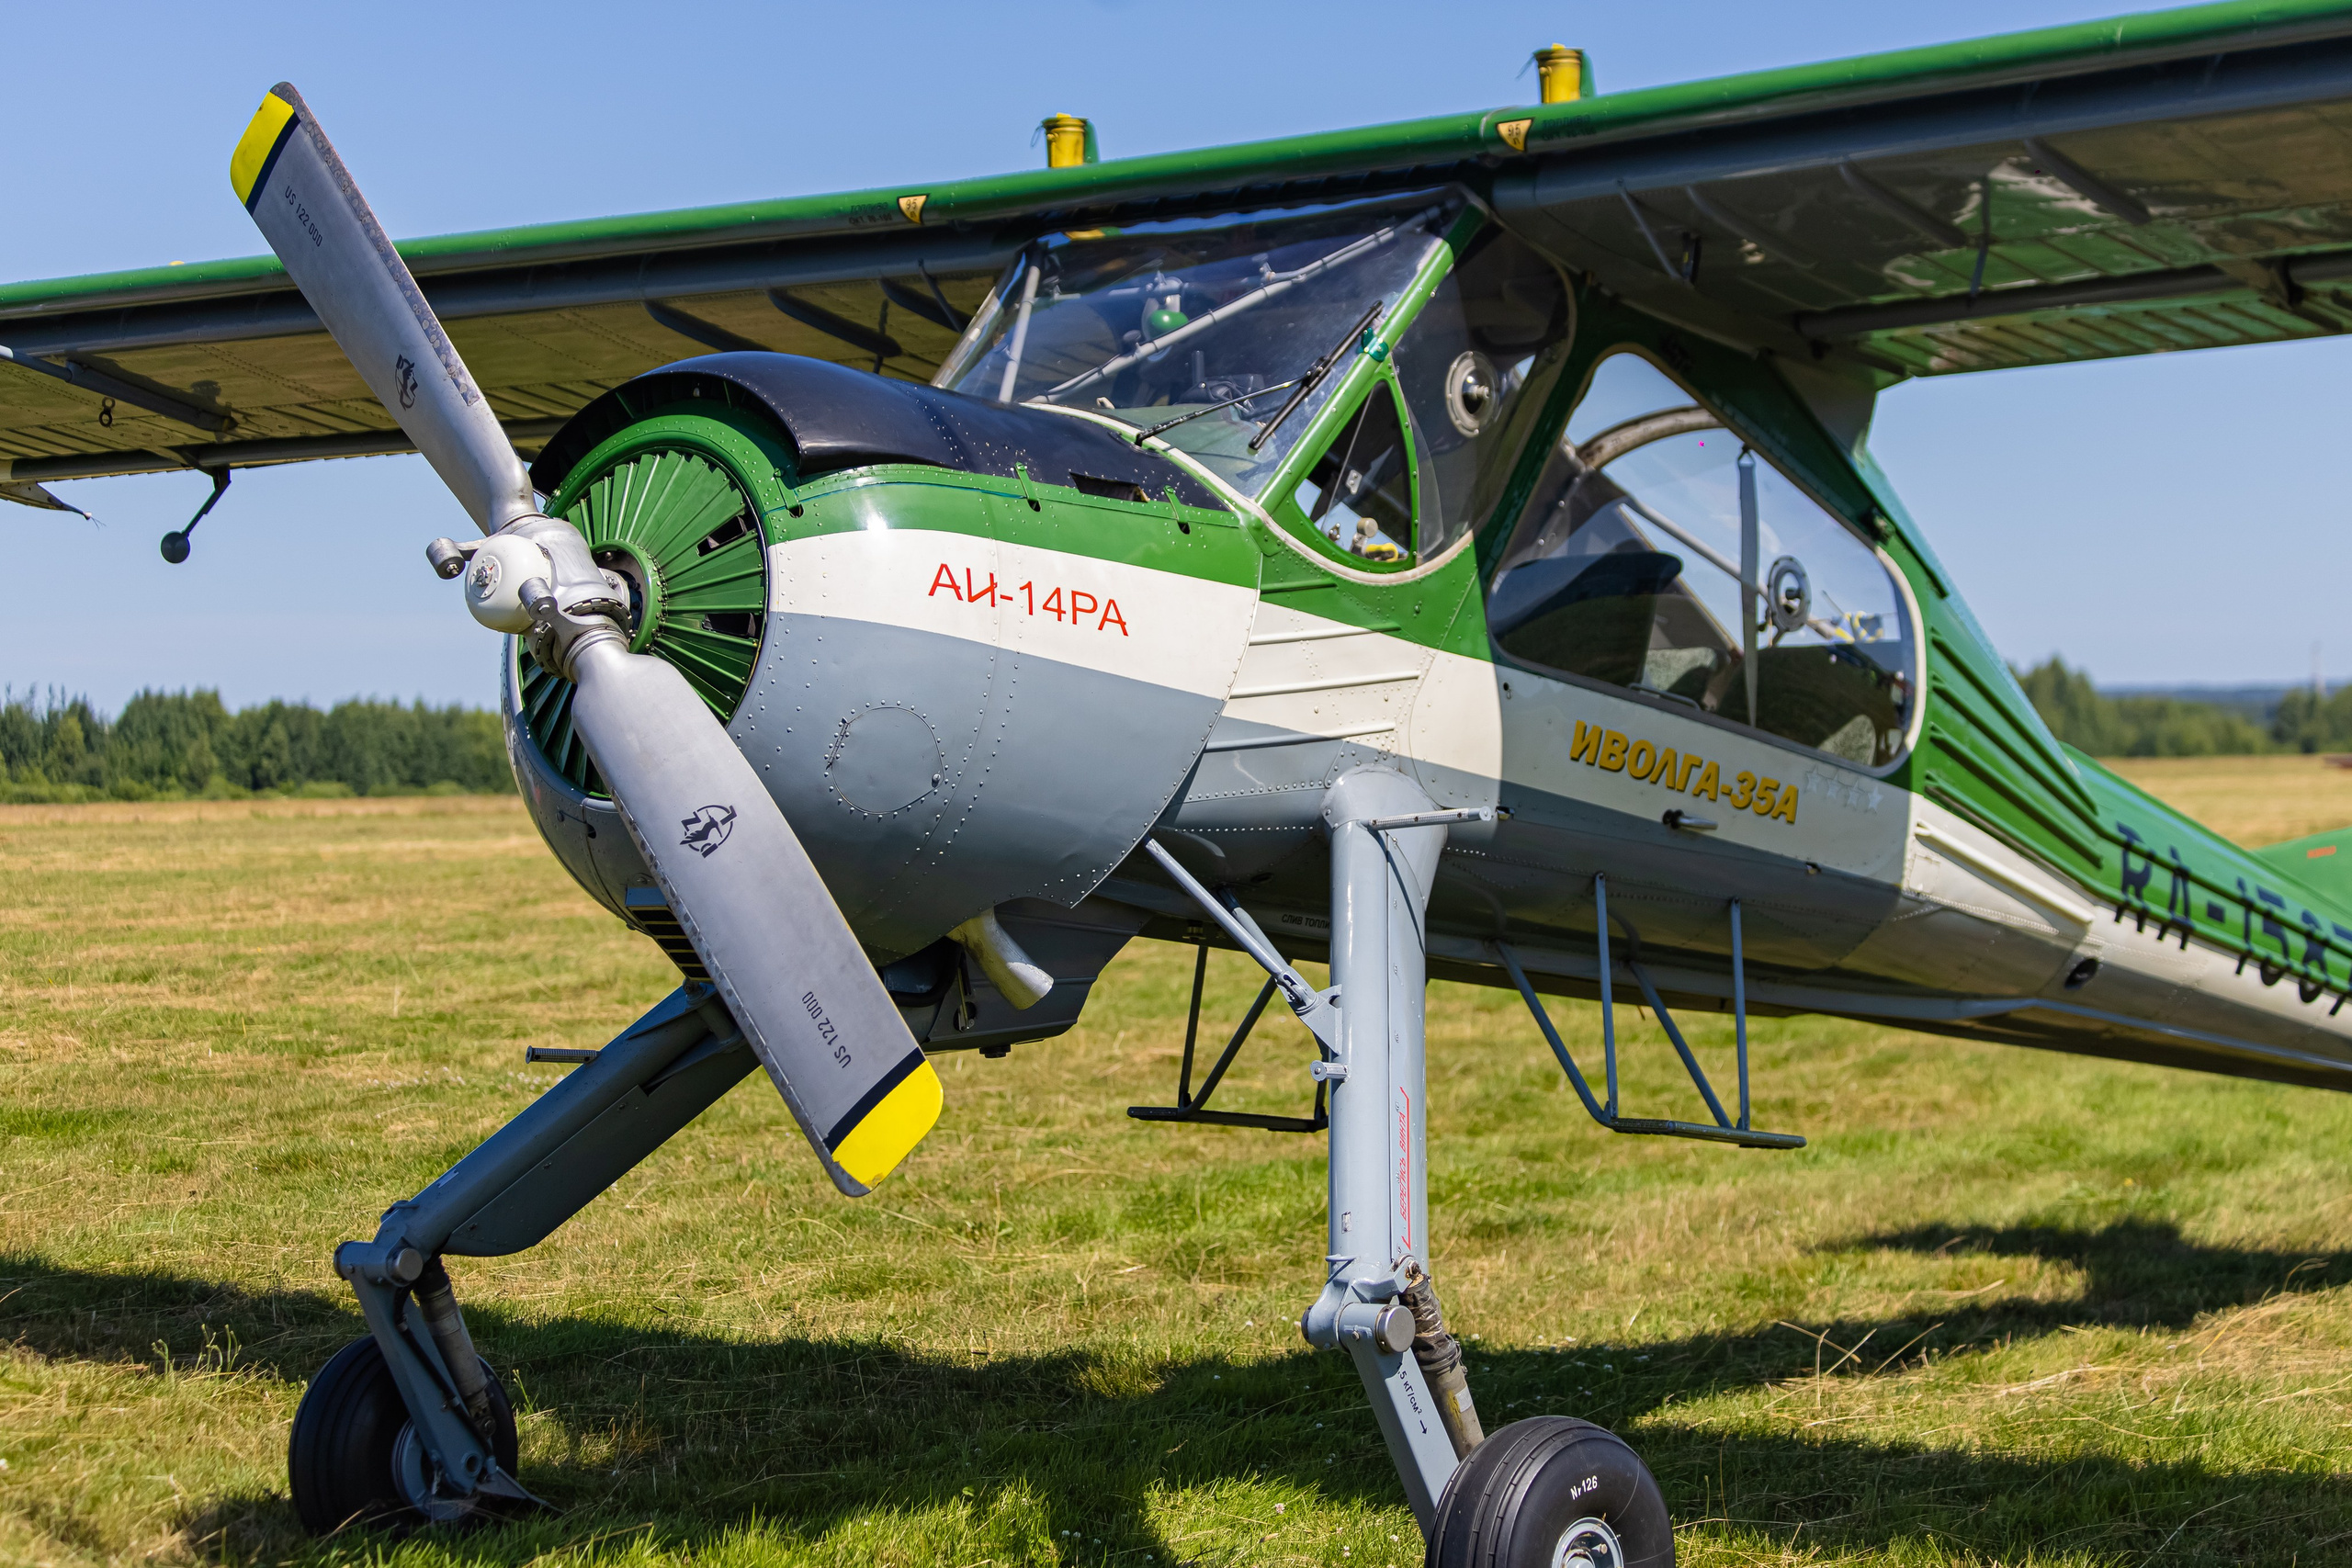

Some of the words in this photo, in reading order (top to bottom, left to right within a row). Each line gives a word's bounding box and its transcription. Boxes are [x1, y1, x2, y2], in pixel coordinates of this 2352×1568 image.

[285, 186, 297, 206] US
[296, 203, 310, 227] 122
[308, 222, 322, 247] 000
[928, 563, 1129, 637] АИ-14РА
[1569, 719, 1799, 824] ИВОЛГА-35А
[1282, 913, 1304, 926] СЛИВ
[801, 991, 823, 1020] 000
[817, 1017, 839, 1045] 122
[834, 1045, 852, 1069] US
[1398, 1111, 1407, 1152] ВИНТА
[1399, 1156, 1408, 1221] БЕРЕГИСЬ
